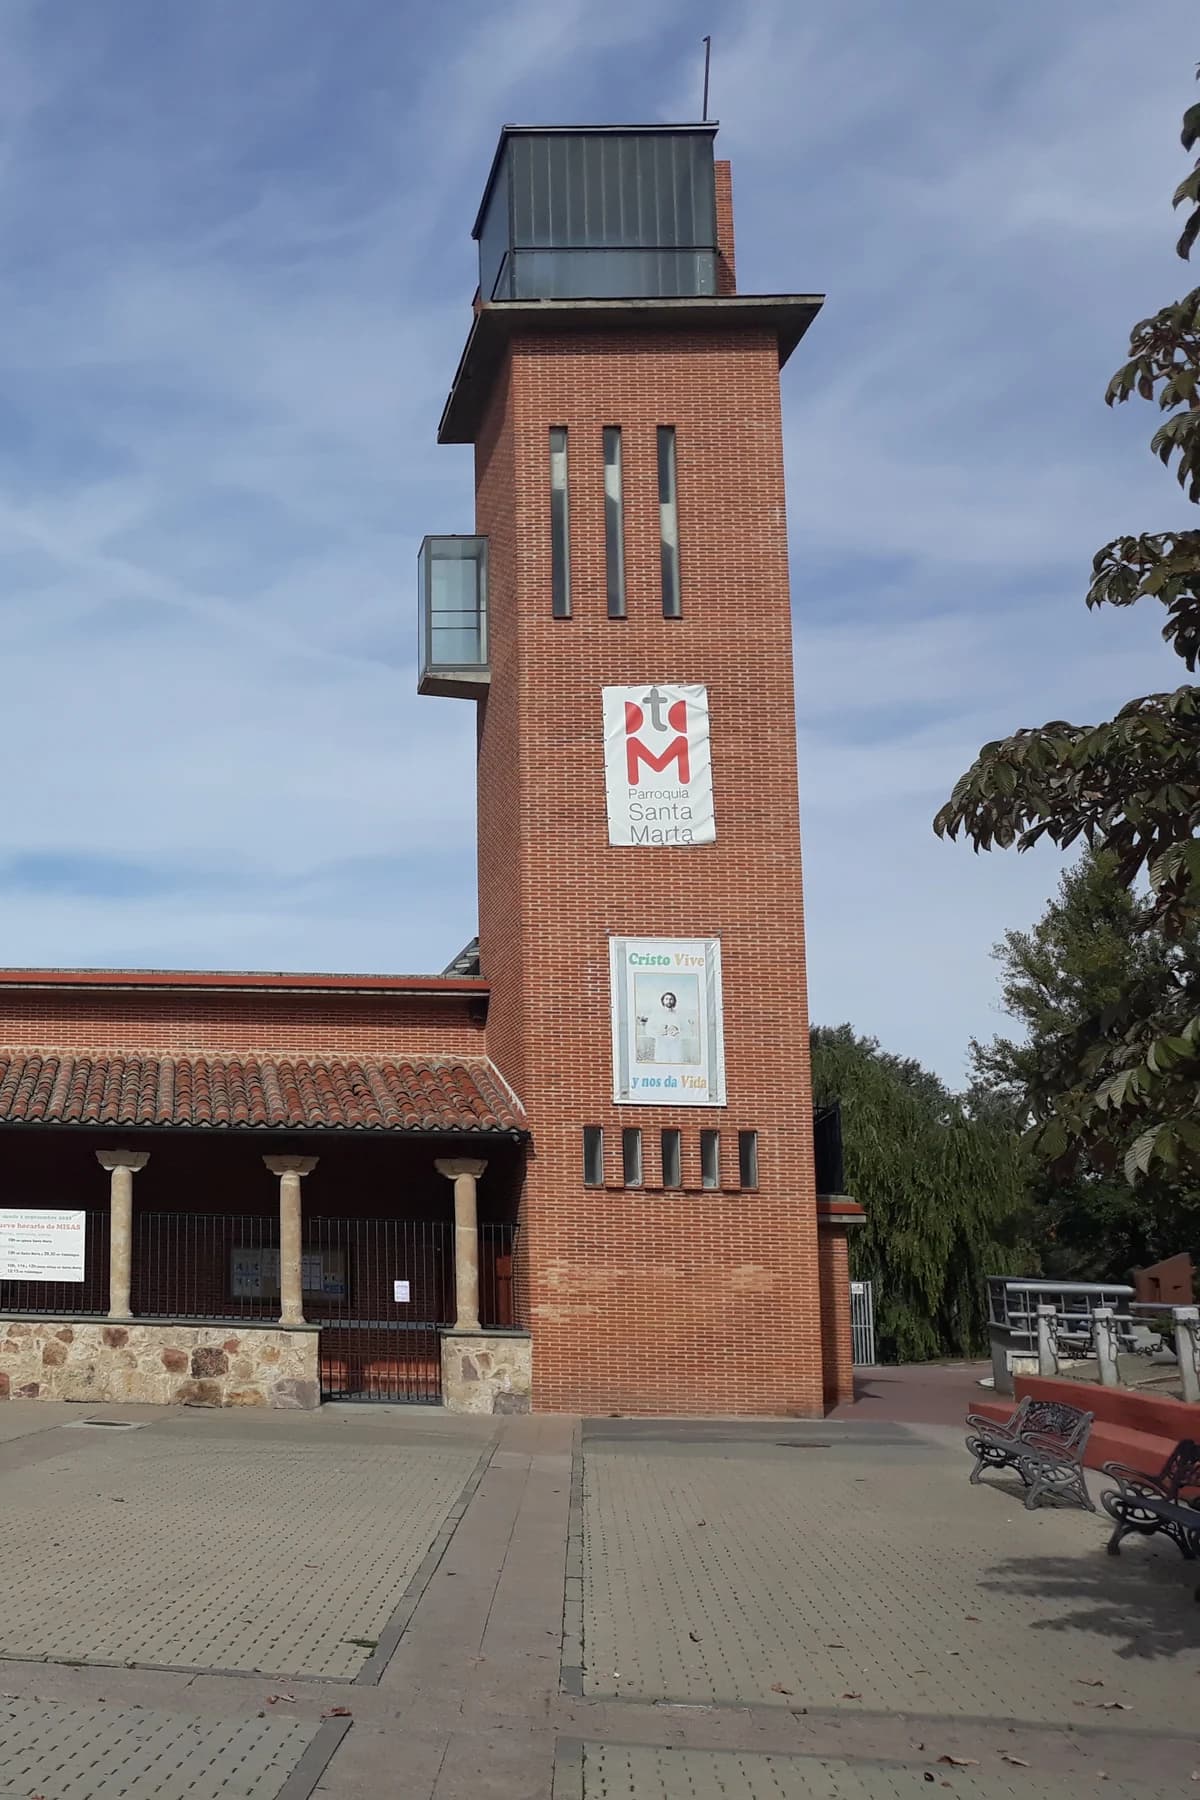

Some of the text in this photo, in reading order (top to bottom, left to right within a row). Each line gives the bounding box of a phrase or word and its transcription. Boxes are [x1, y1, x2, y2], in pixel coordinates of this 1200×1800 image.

[628, 788, 689, 801] Parroquia
[628, 802, 693, 821] Santa
[630, 825, 694, 844] Marta
[628, 952, 704, 967] Cristo Vive
[631, 1075, 707, 1089] y nos da Vida
